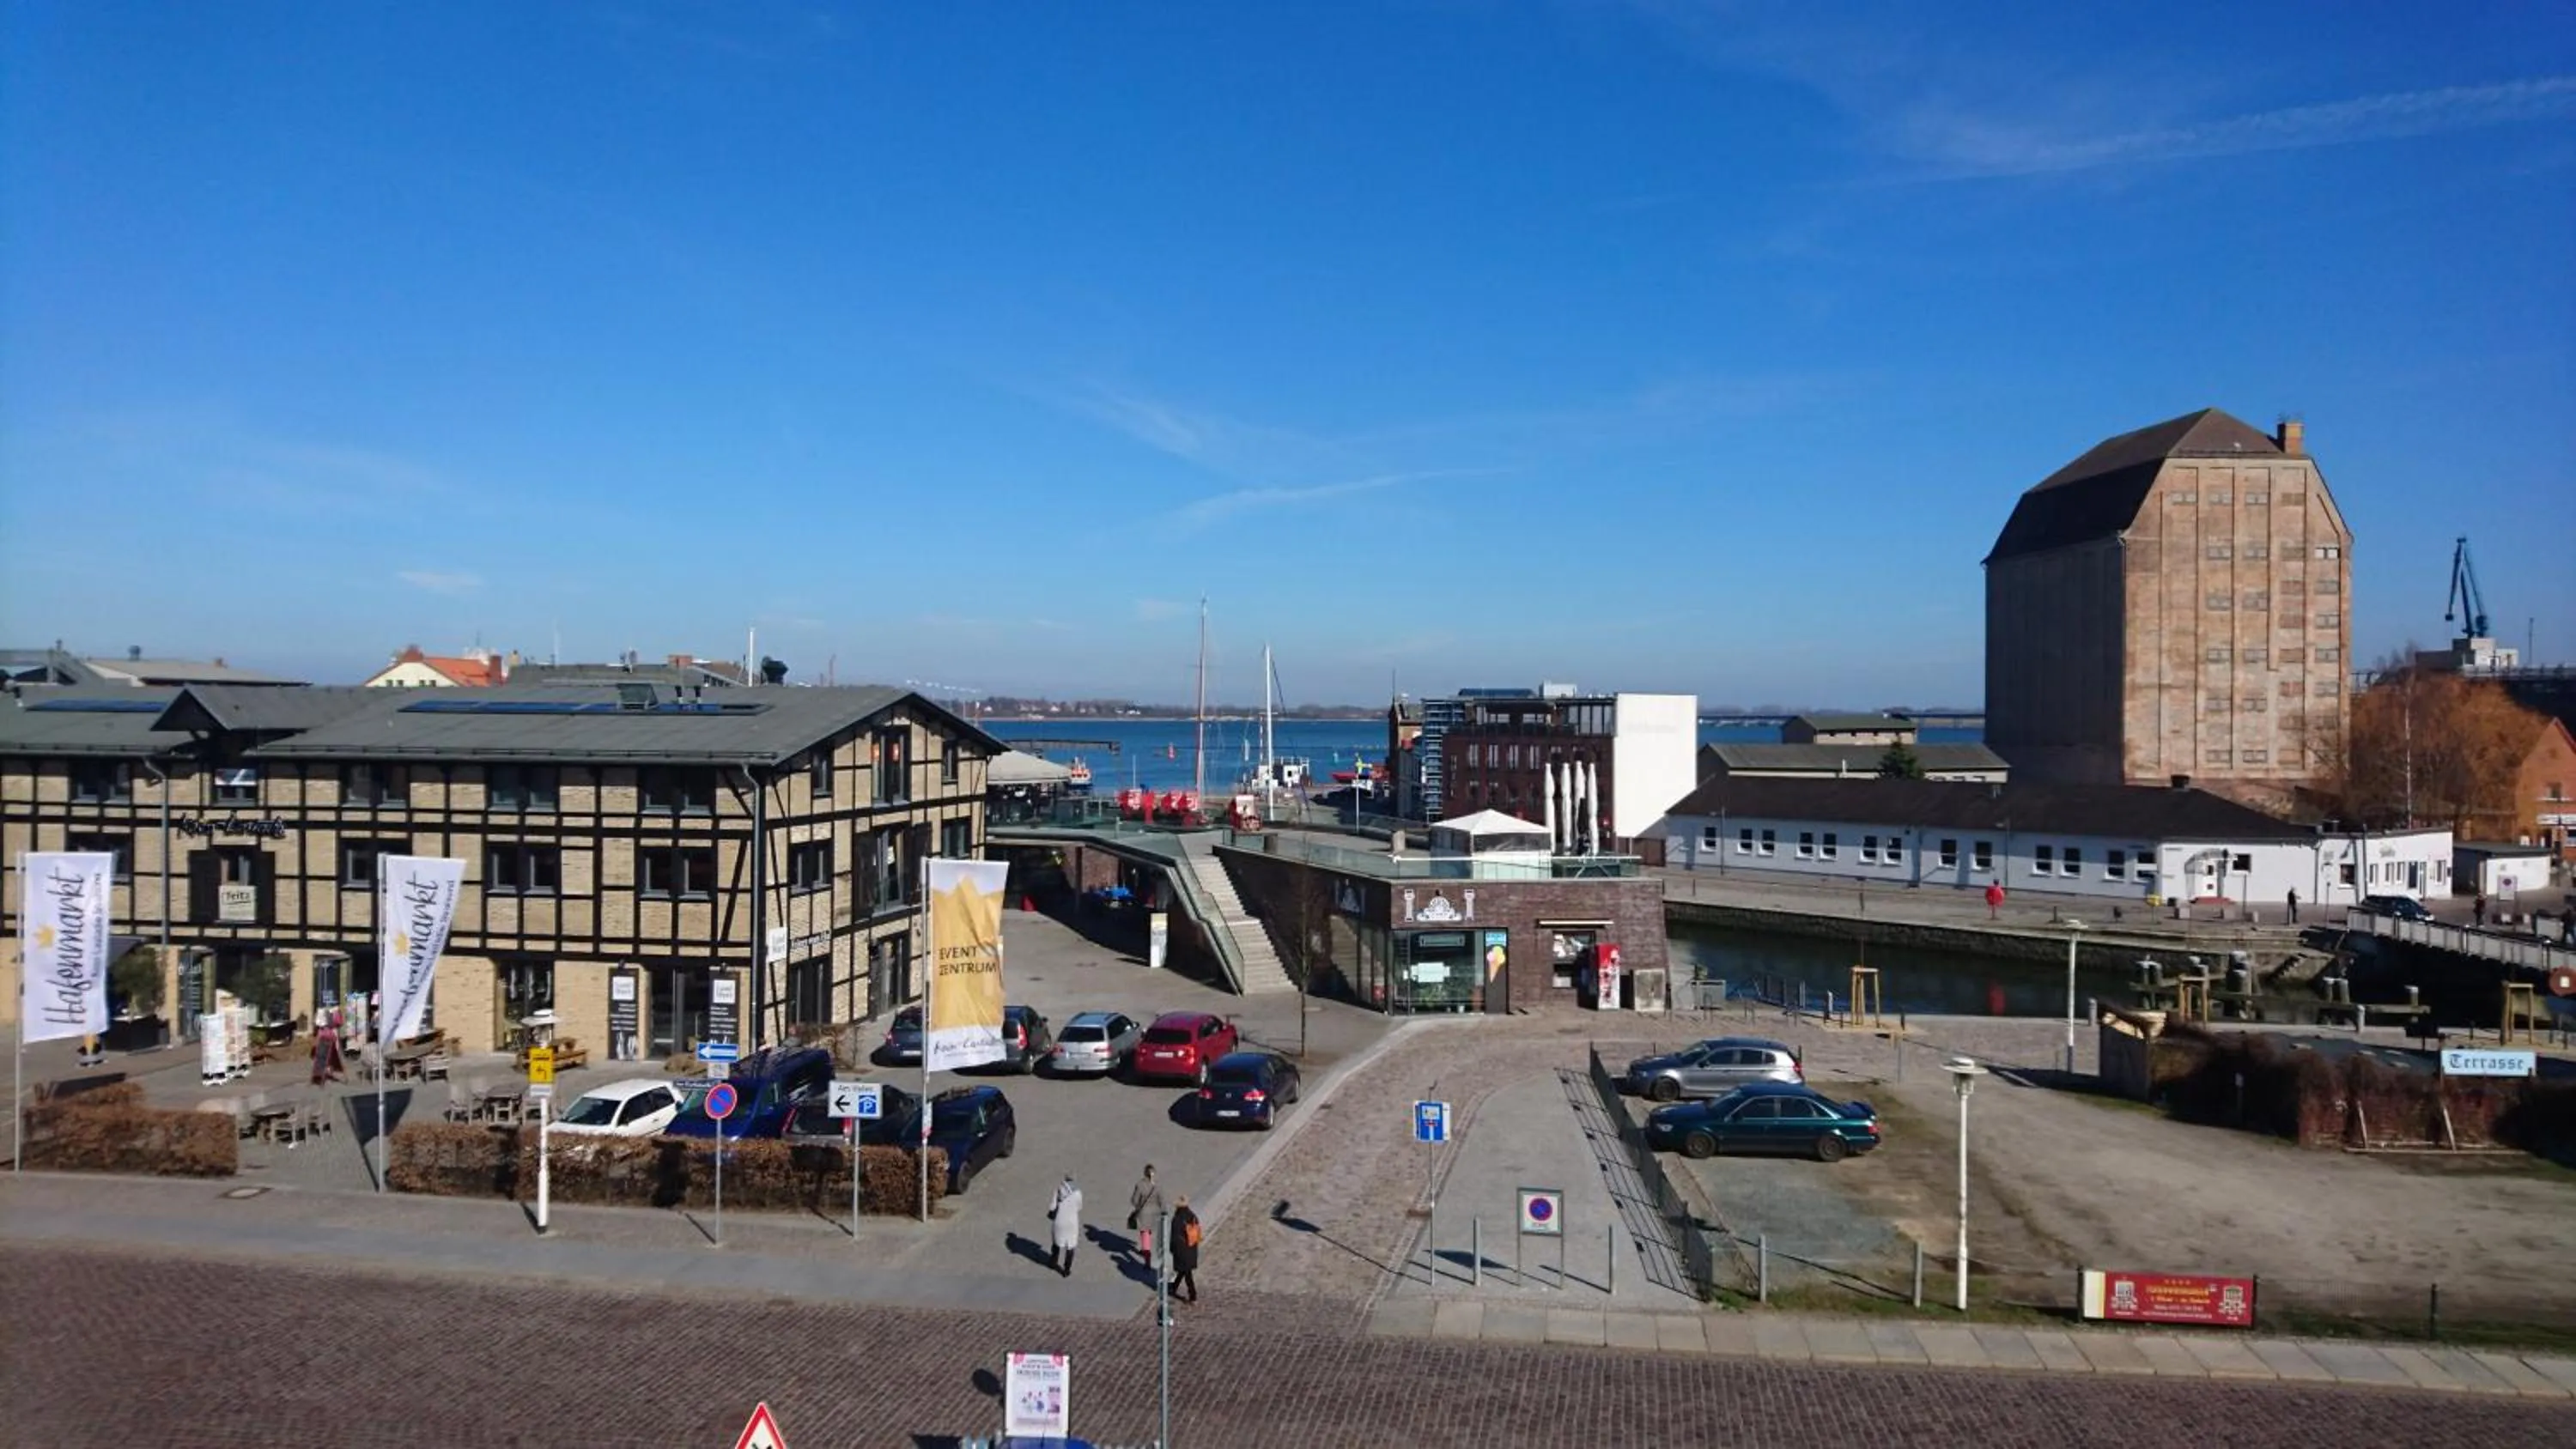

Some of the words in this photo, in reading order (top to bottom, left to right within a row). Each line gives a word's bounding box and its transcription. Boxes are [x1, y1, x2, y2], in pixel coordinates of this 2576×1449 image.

[42, 866, 92, 1024] Hafenmarkt
[939, 946, 978, 961] EVENT
[938, 961, 997, 976] ZENTRUM
[2449, 1053, 2524, 1070] Terrasse
